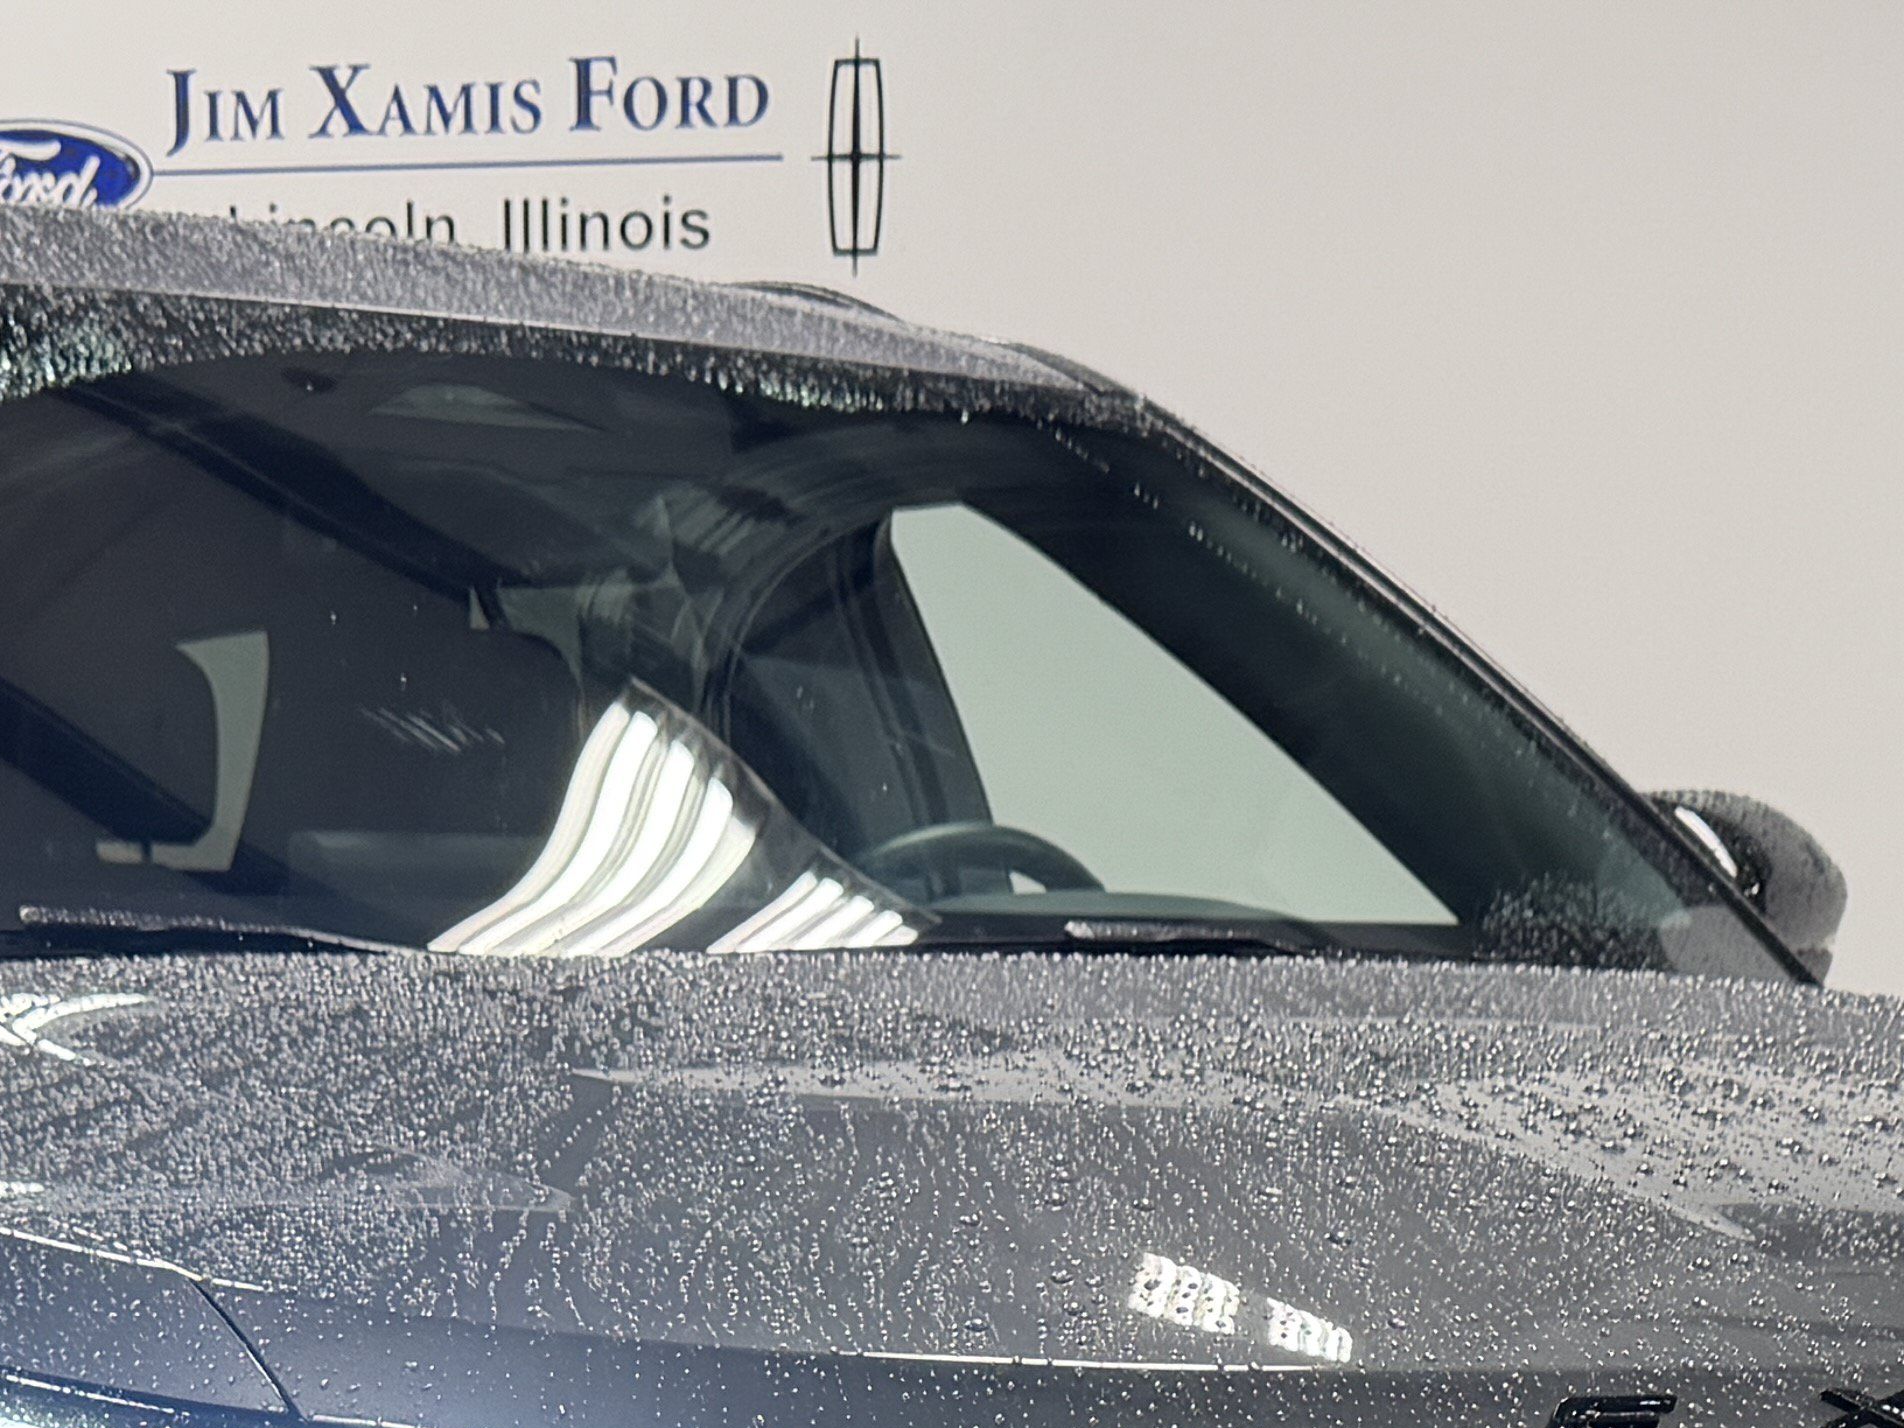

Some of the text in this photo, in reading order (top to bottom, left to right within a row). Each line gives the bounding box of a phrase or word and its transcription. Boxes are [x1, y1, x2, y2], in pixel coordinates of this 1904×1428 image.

[165, 56, 770, 157] JIM XAMIS FORD
[502, 195, 712, 252] Illinois
